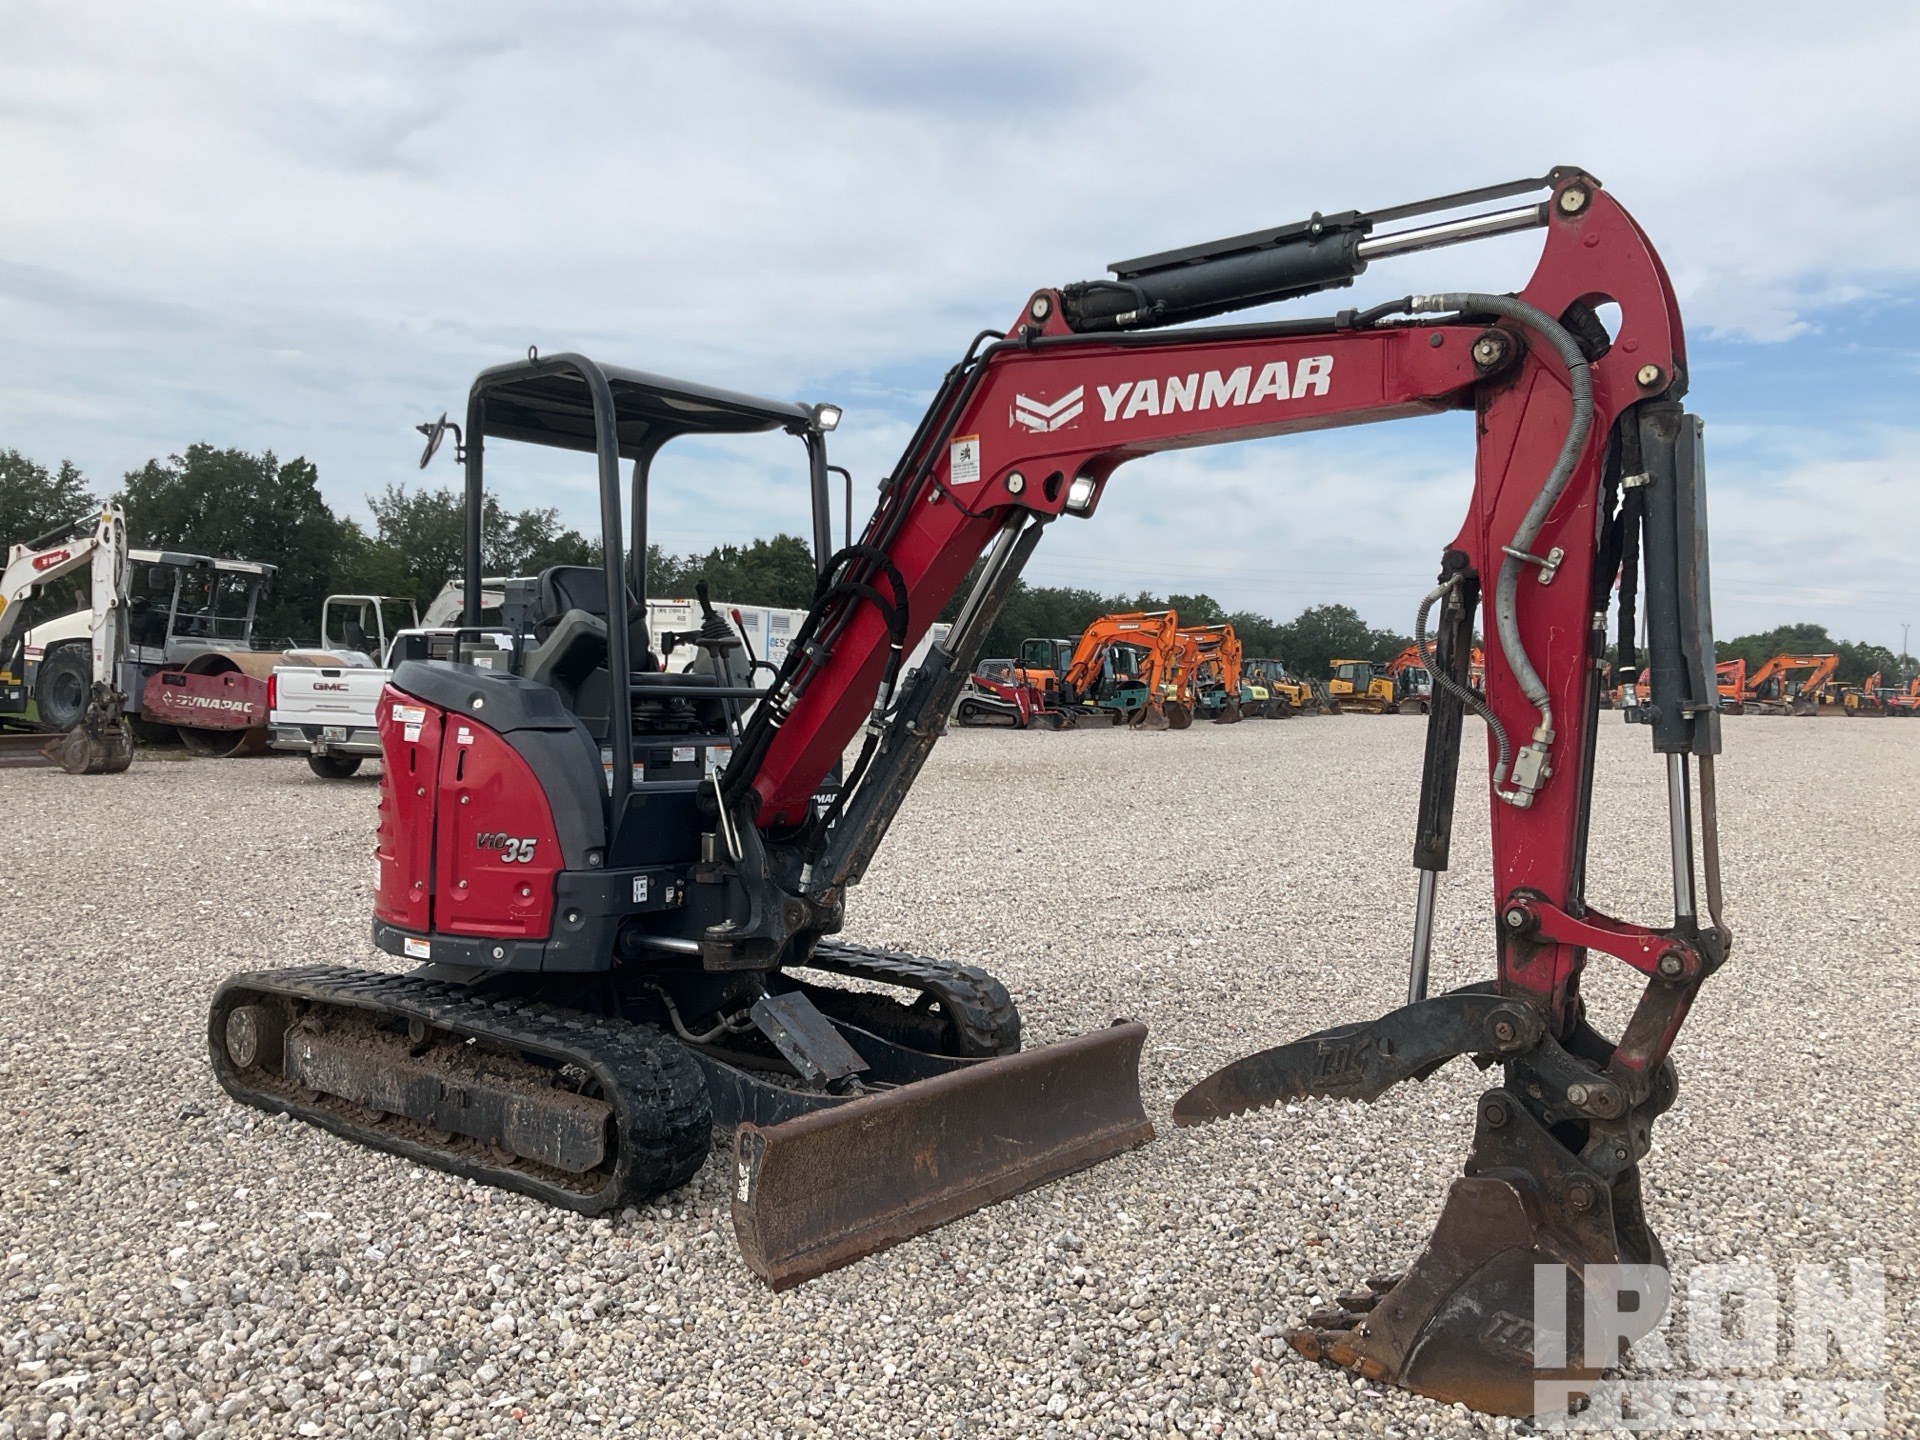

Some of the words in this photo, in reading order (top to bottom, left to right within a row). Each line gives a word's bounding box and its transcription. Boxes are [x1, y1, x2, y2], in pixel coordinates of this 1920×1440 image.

[1097, 355, 1334, 422] YANMAR
[313, 682, 349, 691] GMC
[176, 695, 254, 713] DYNAPAC
